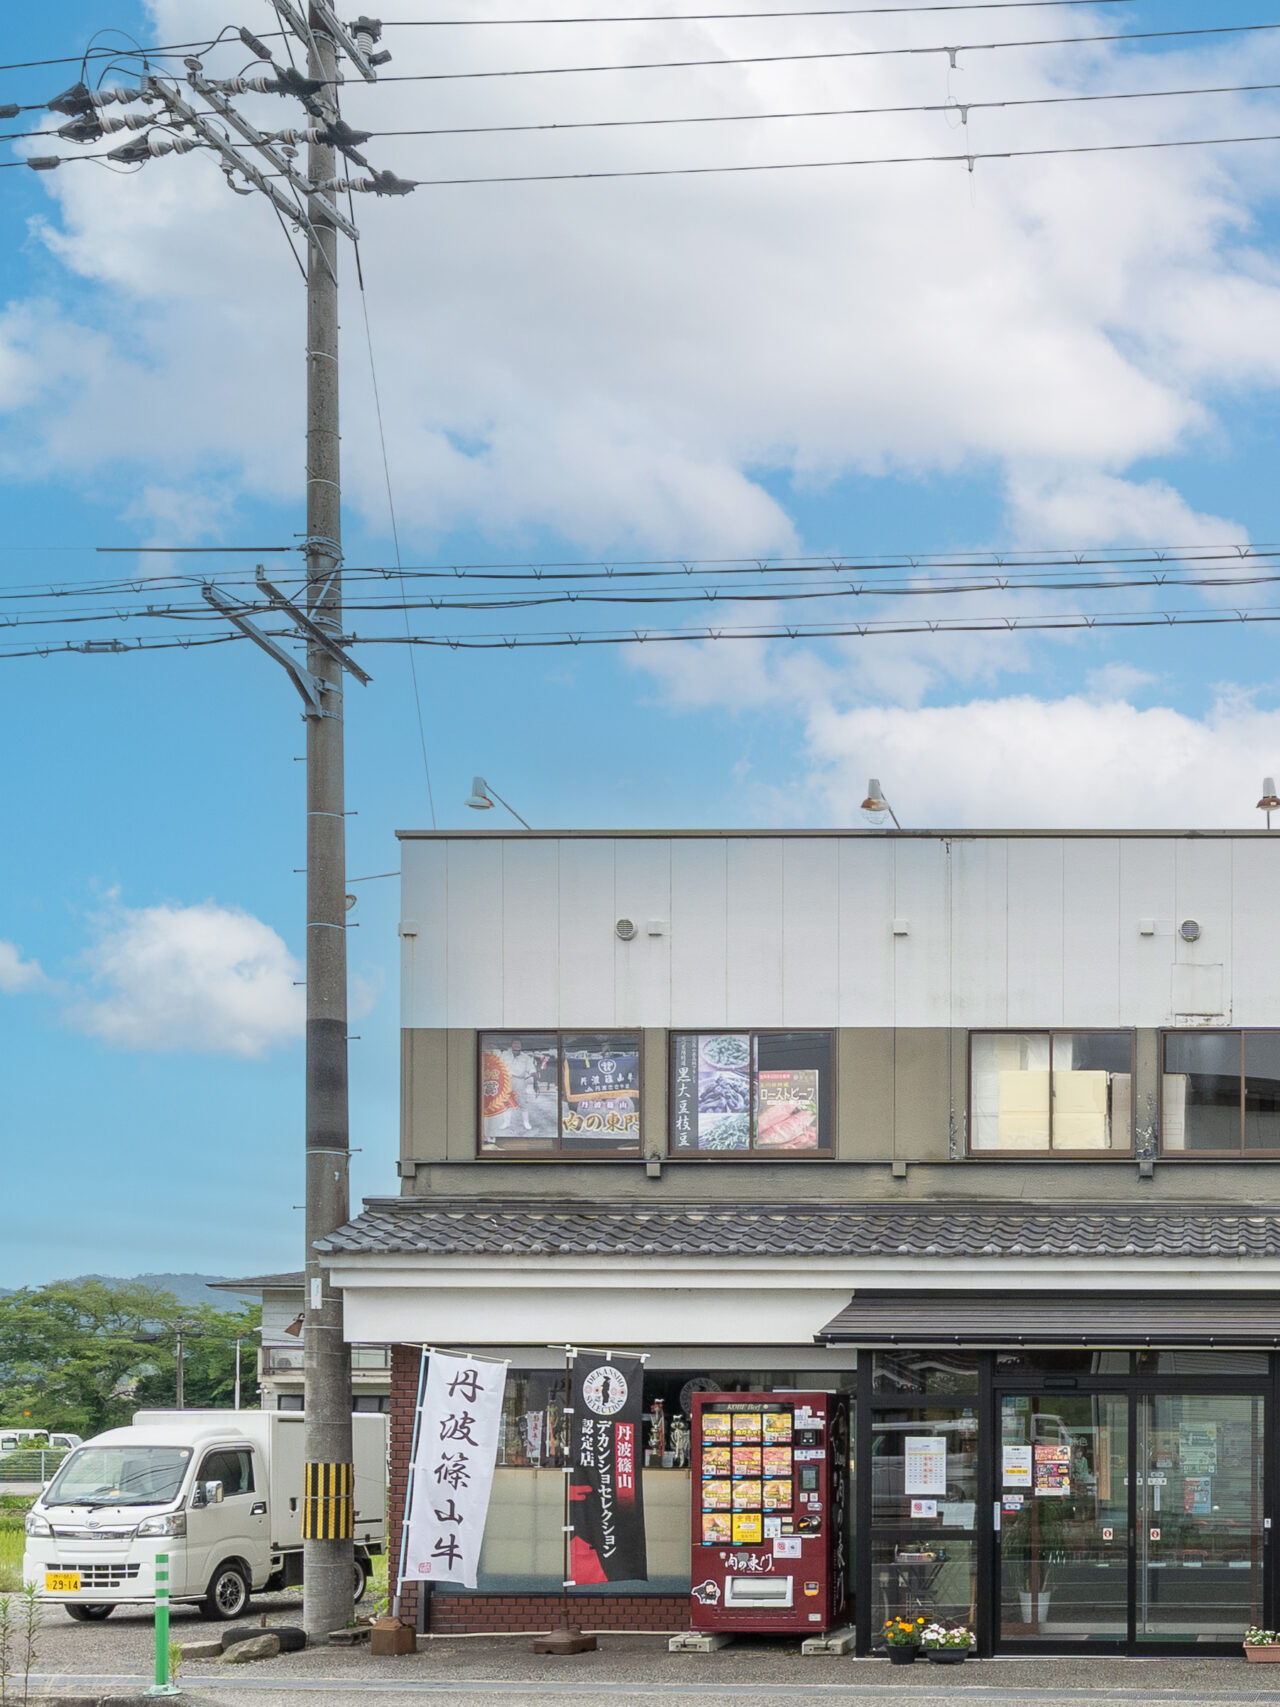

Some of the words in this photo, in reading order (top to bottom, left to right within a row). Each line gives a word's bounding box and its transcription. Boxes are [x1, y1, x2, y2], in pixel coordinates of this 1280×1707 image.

[677, 1067, 691, 1147] 黒大豆枝豆
[760, 1088, 815, 1100] ローストビーフ
[431, 1369, 484, 1571] 丹波篠山牛
[579, 1419, 595, 1467] 認定店
[616, 1425, 632, 1489] 丹波篠山
[596, 1420, 617, 1558] デカンショセレクション
